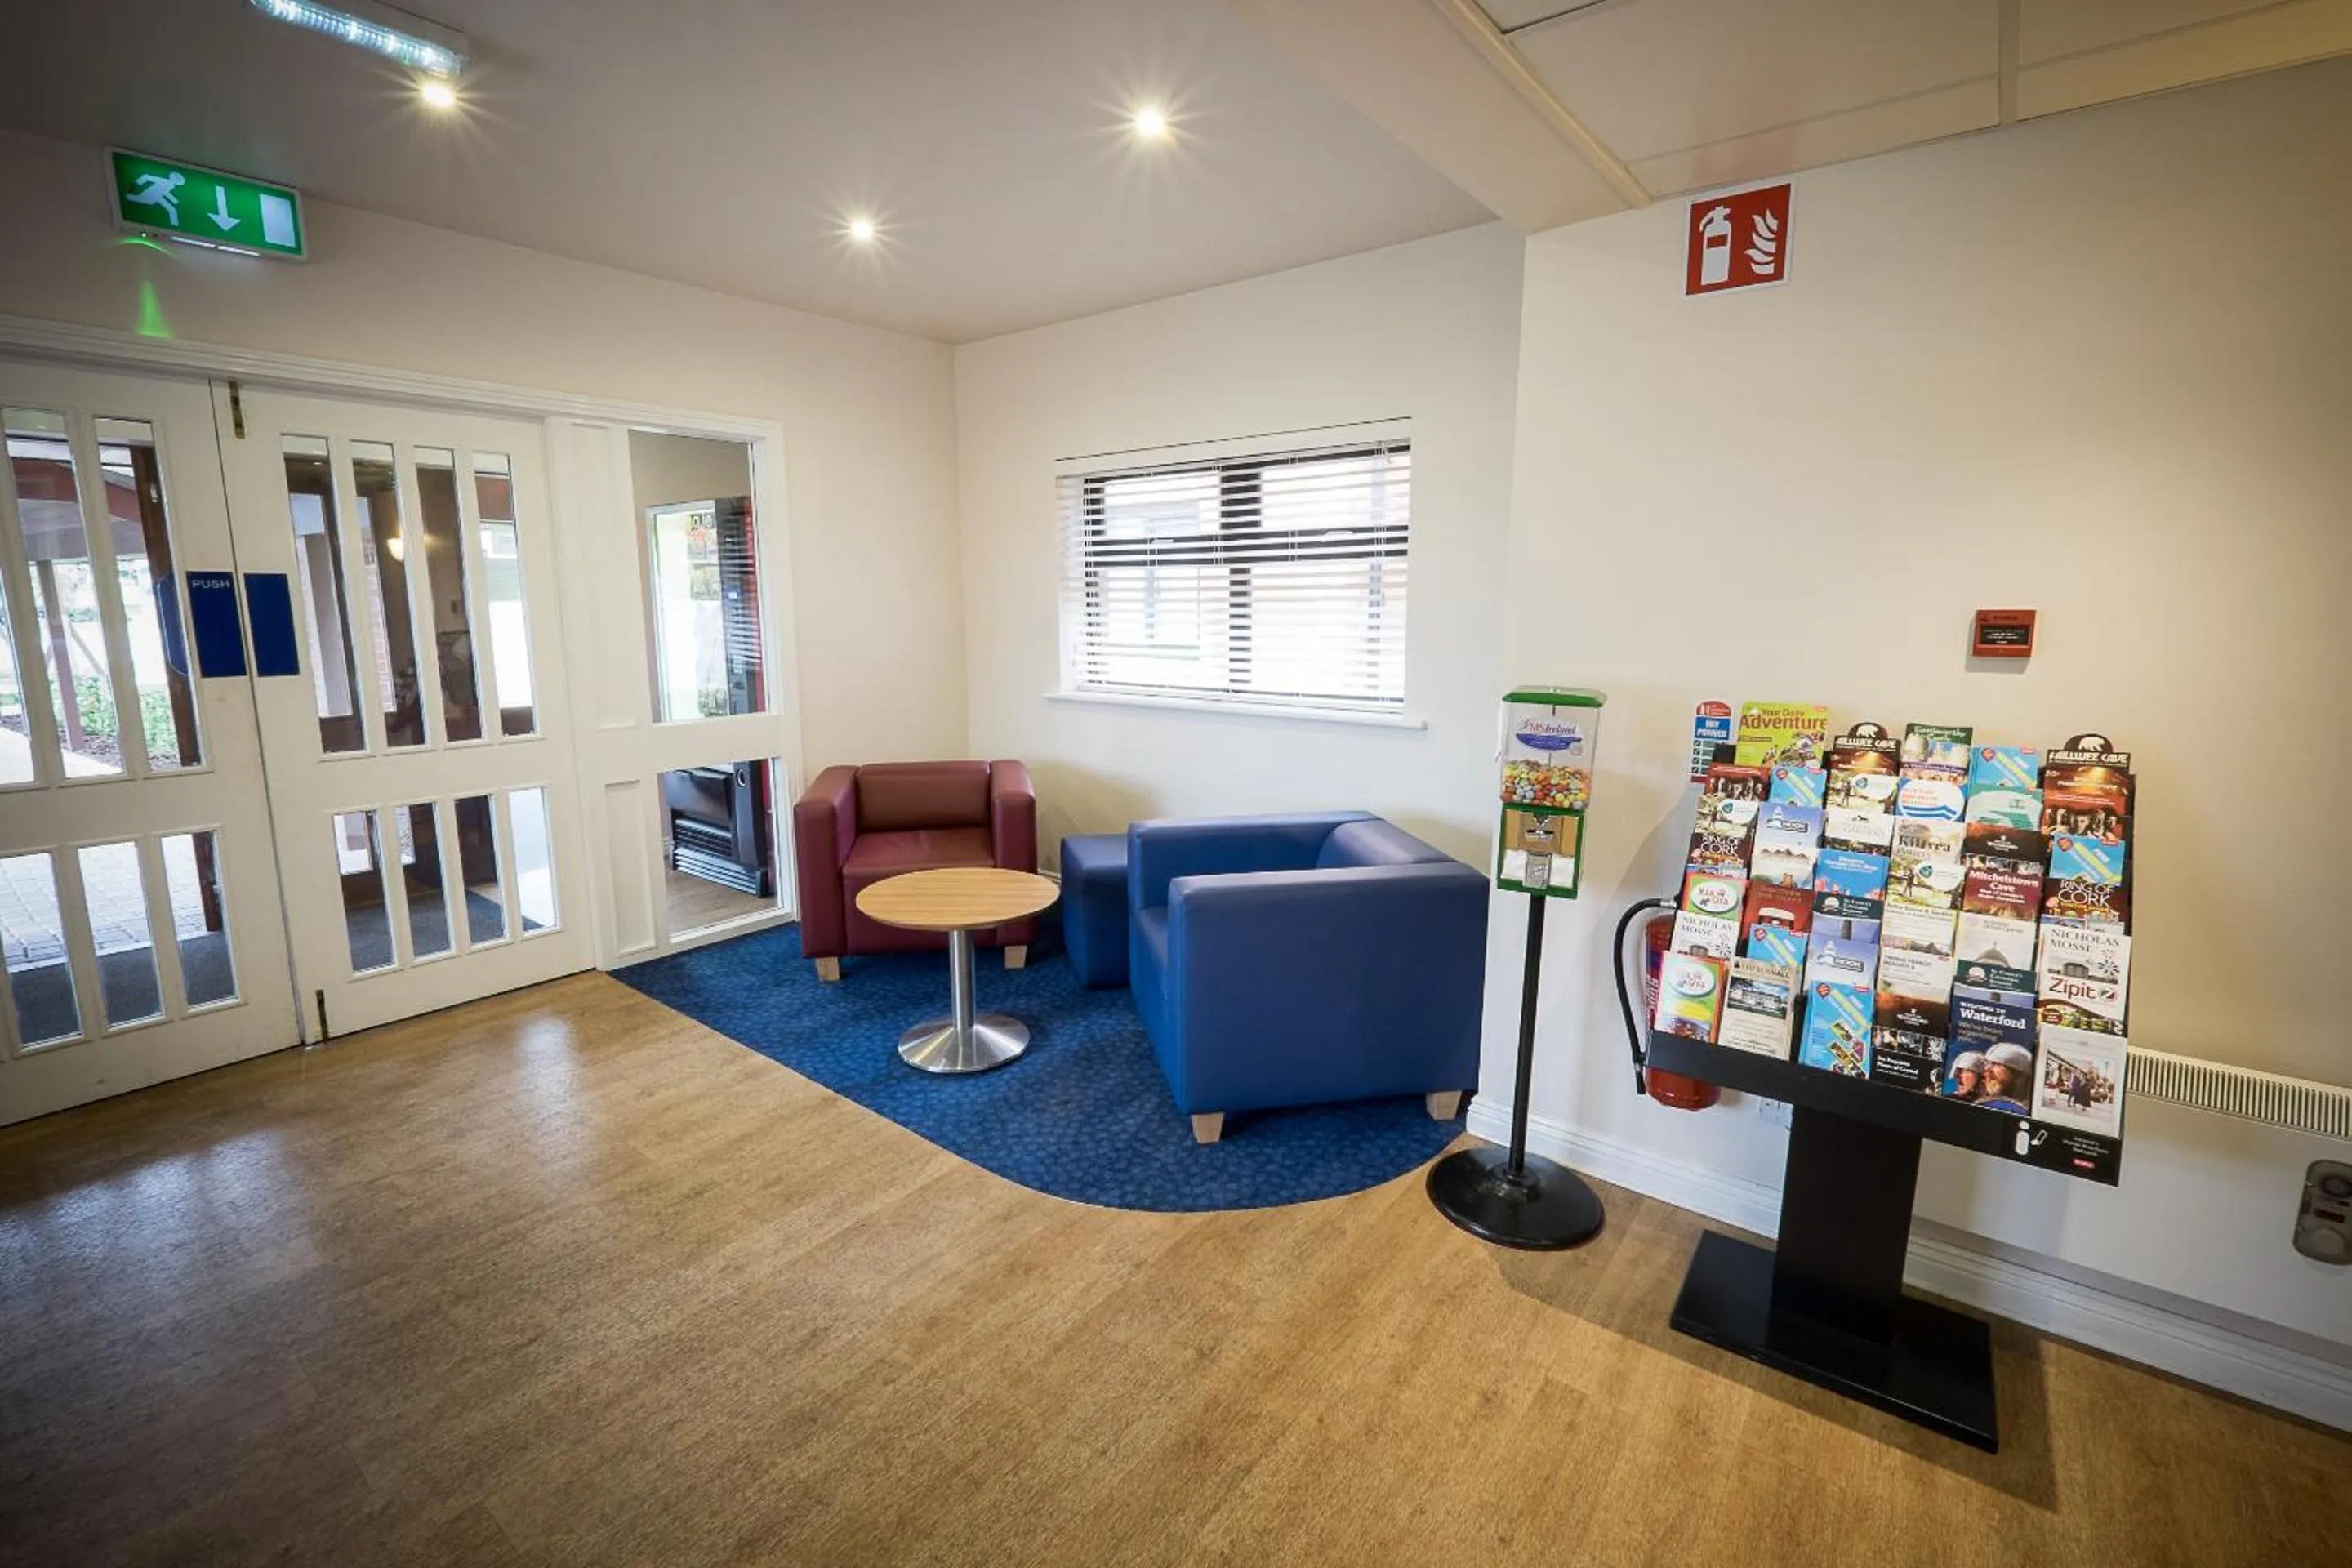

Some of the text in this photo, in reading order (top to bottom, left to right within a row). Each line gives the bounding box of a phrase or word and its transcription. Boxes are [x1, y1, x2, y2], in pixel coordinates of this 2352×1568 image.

[192, 579, 229, 589] PUSH
[1740, 715, 1828, 730] Adventure
[2101, 752, 2129, 763] CAVE
[1700, 843, 1739, 857] CORK
[1969, 870, 2039, 887] Mitchelstown
[1989, 881, 2016, 892] Cave
[2060, 879, 2115, 895] RING OF
[2058, 889, 2111, 907] CORK
[1682, 916, 1733, 930] NICHOLAS
[1681, 924, 1713, 937] MOSSE
[2051, 928, 2121, 947] NICHOLAS
[2050, 938, 2091, 952] MOSSE
[1836, 958, 1862, 968] HOOK
[2048, 976, 2096, 1000] Zipit
[1960, 1008, 2026, 1030] Waterford
